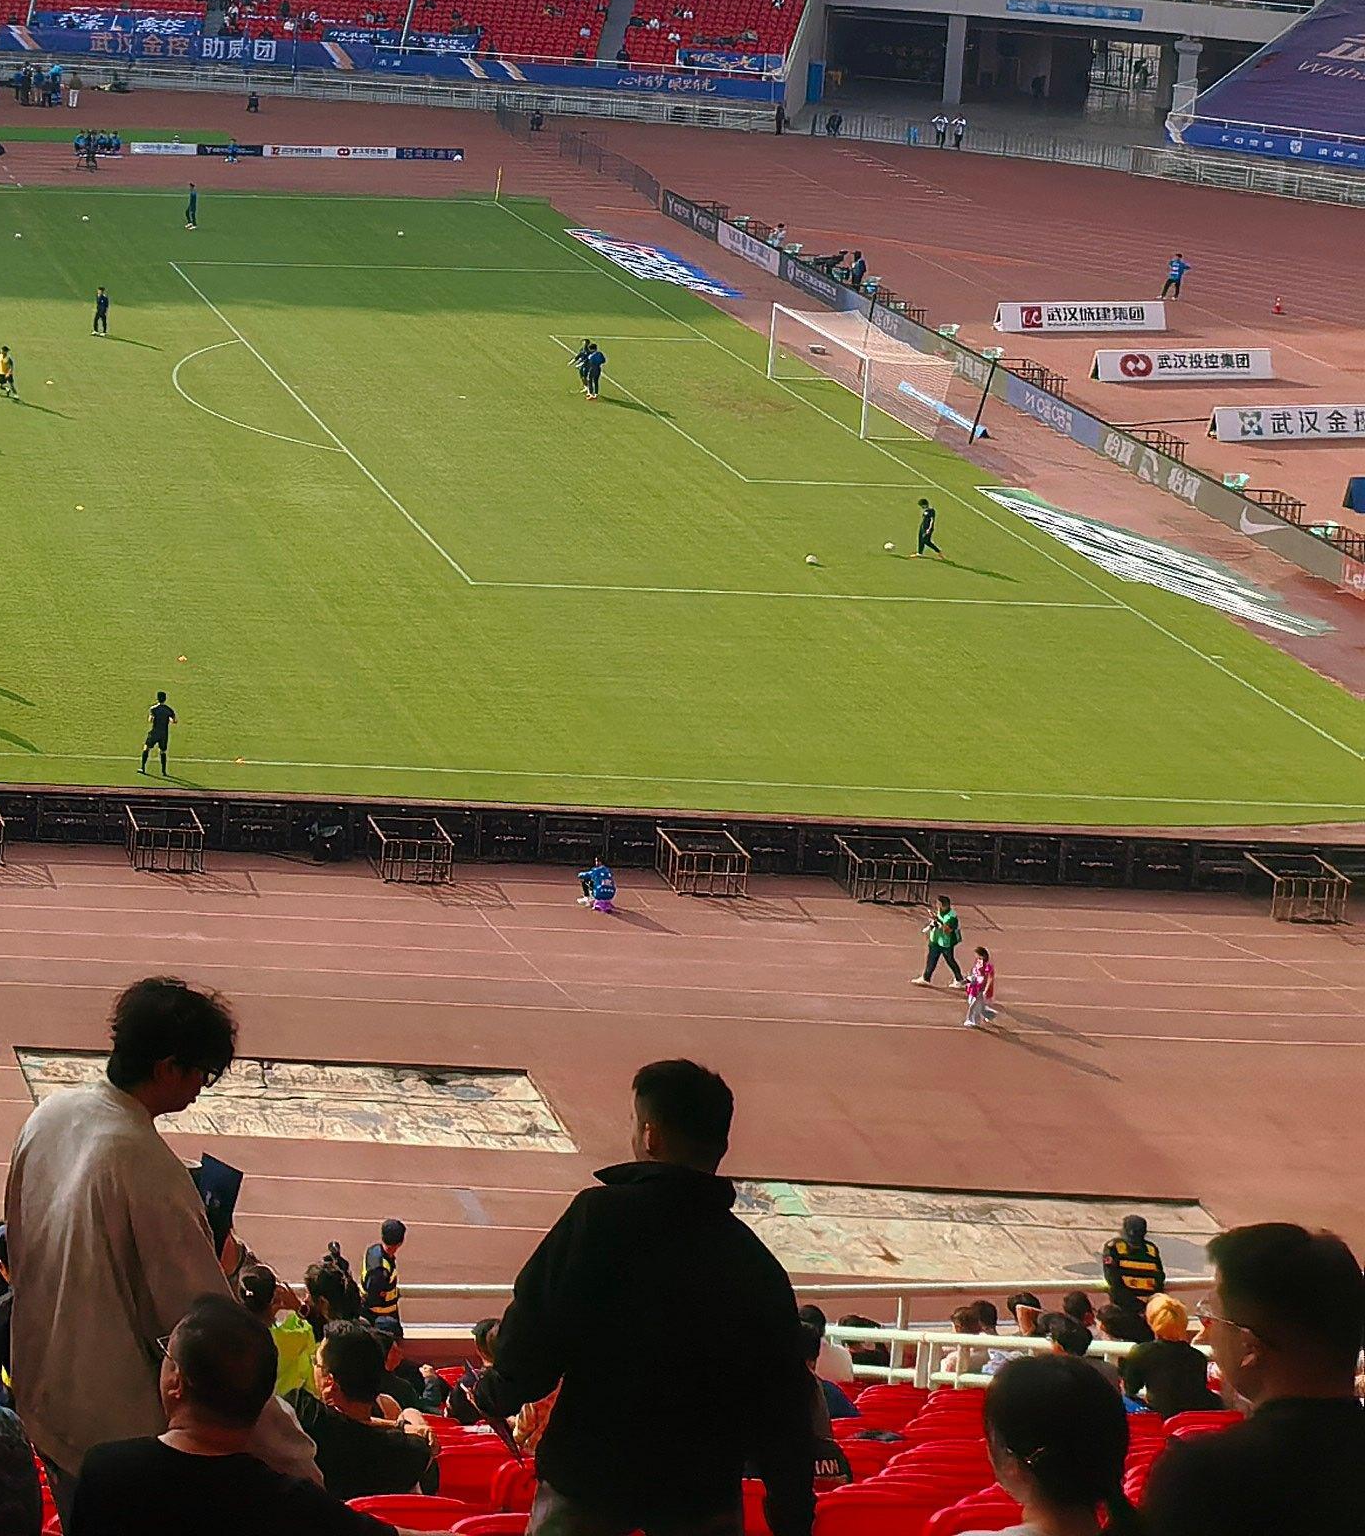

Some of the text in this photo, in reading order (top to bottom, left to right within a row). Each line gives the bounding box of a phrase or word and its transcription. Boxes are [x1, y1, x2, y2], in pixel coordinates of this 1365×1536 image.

[1157, 353, 1250, 369] 武汉投控集团
